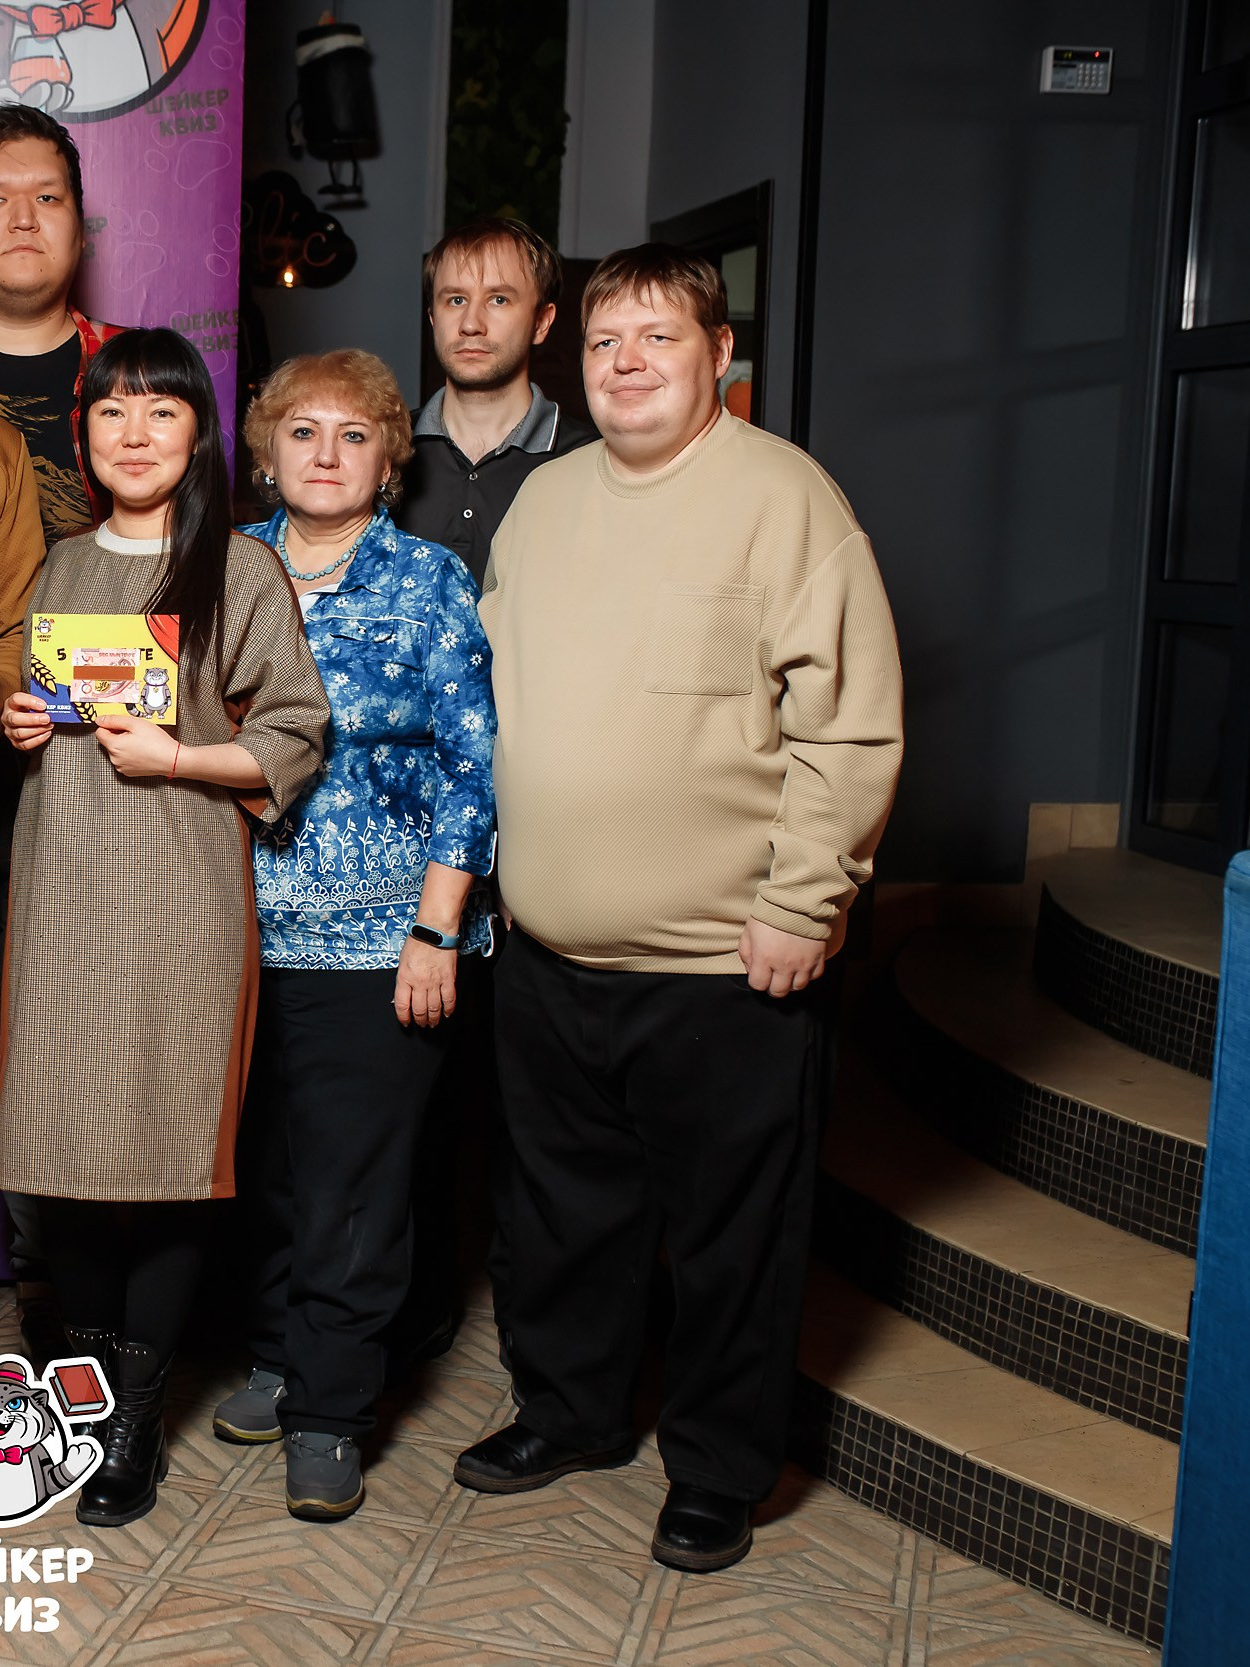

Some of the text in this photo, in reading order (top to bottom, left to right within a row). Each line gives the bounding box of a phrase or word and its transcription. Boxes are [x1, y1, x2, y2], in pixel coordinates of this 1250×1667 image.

[145, 88, 230, 115] ШЕЙКЕР
[160, 114, 218, 137] КВИЗ
[56, 647, 67, 661] 5
